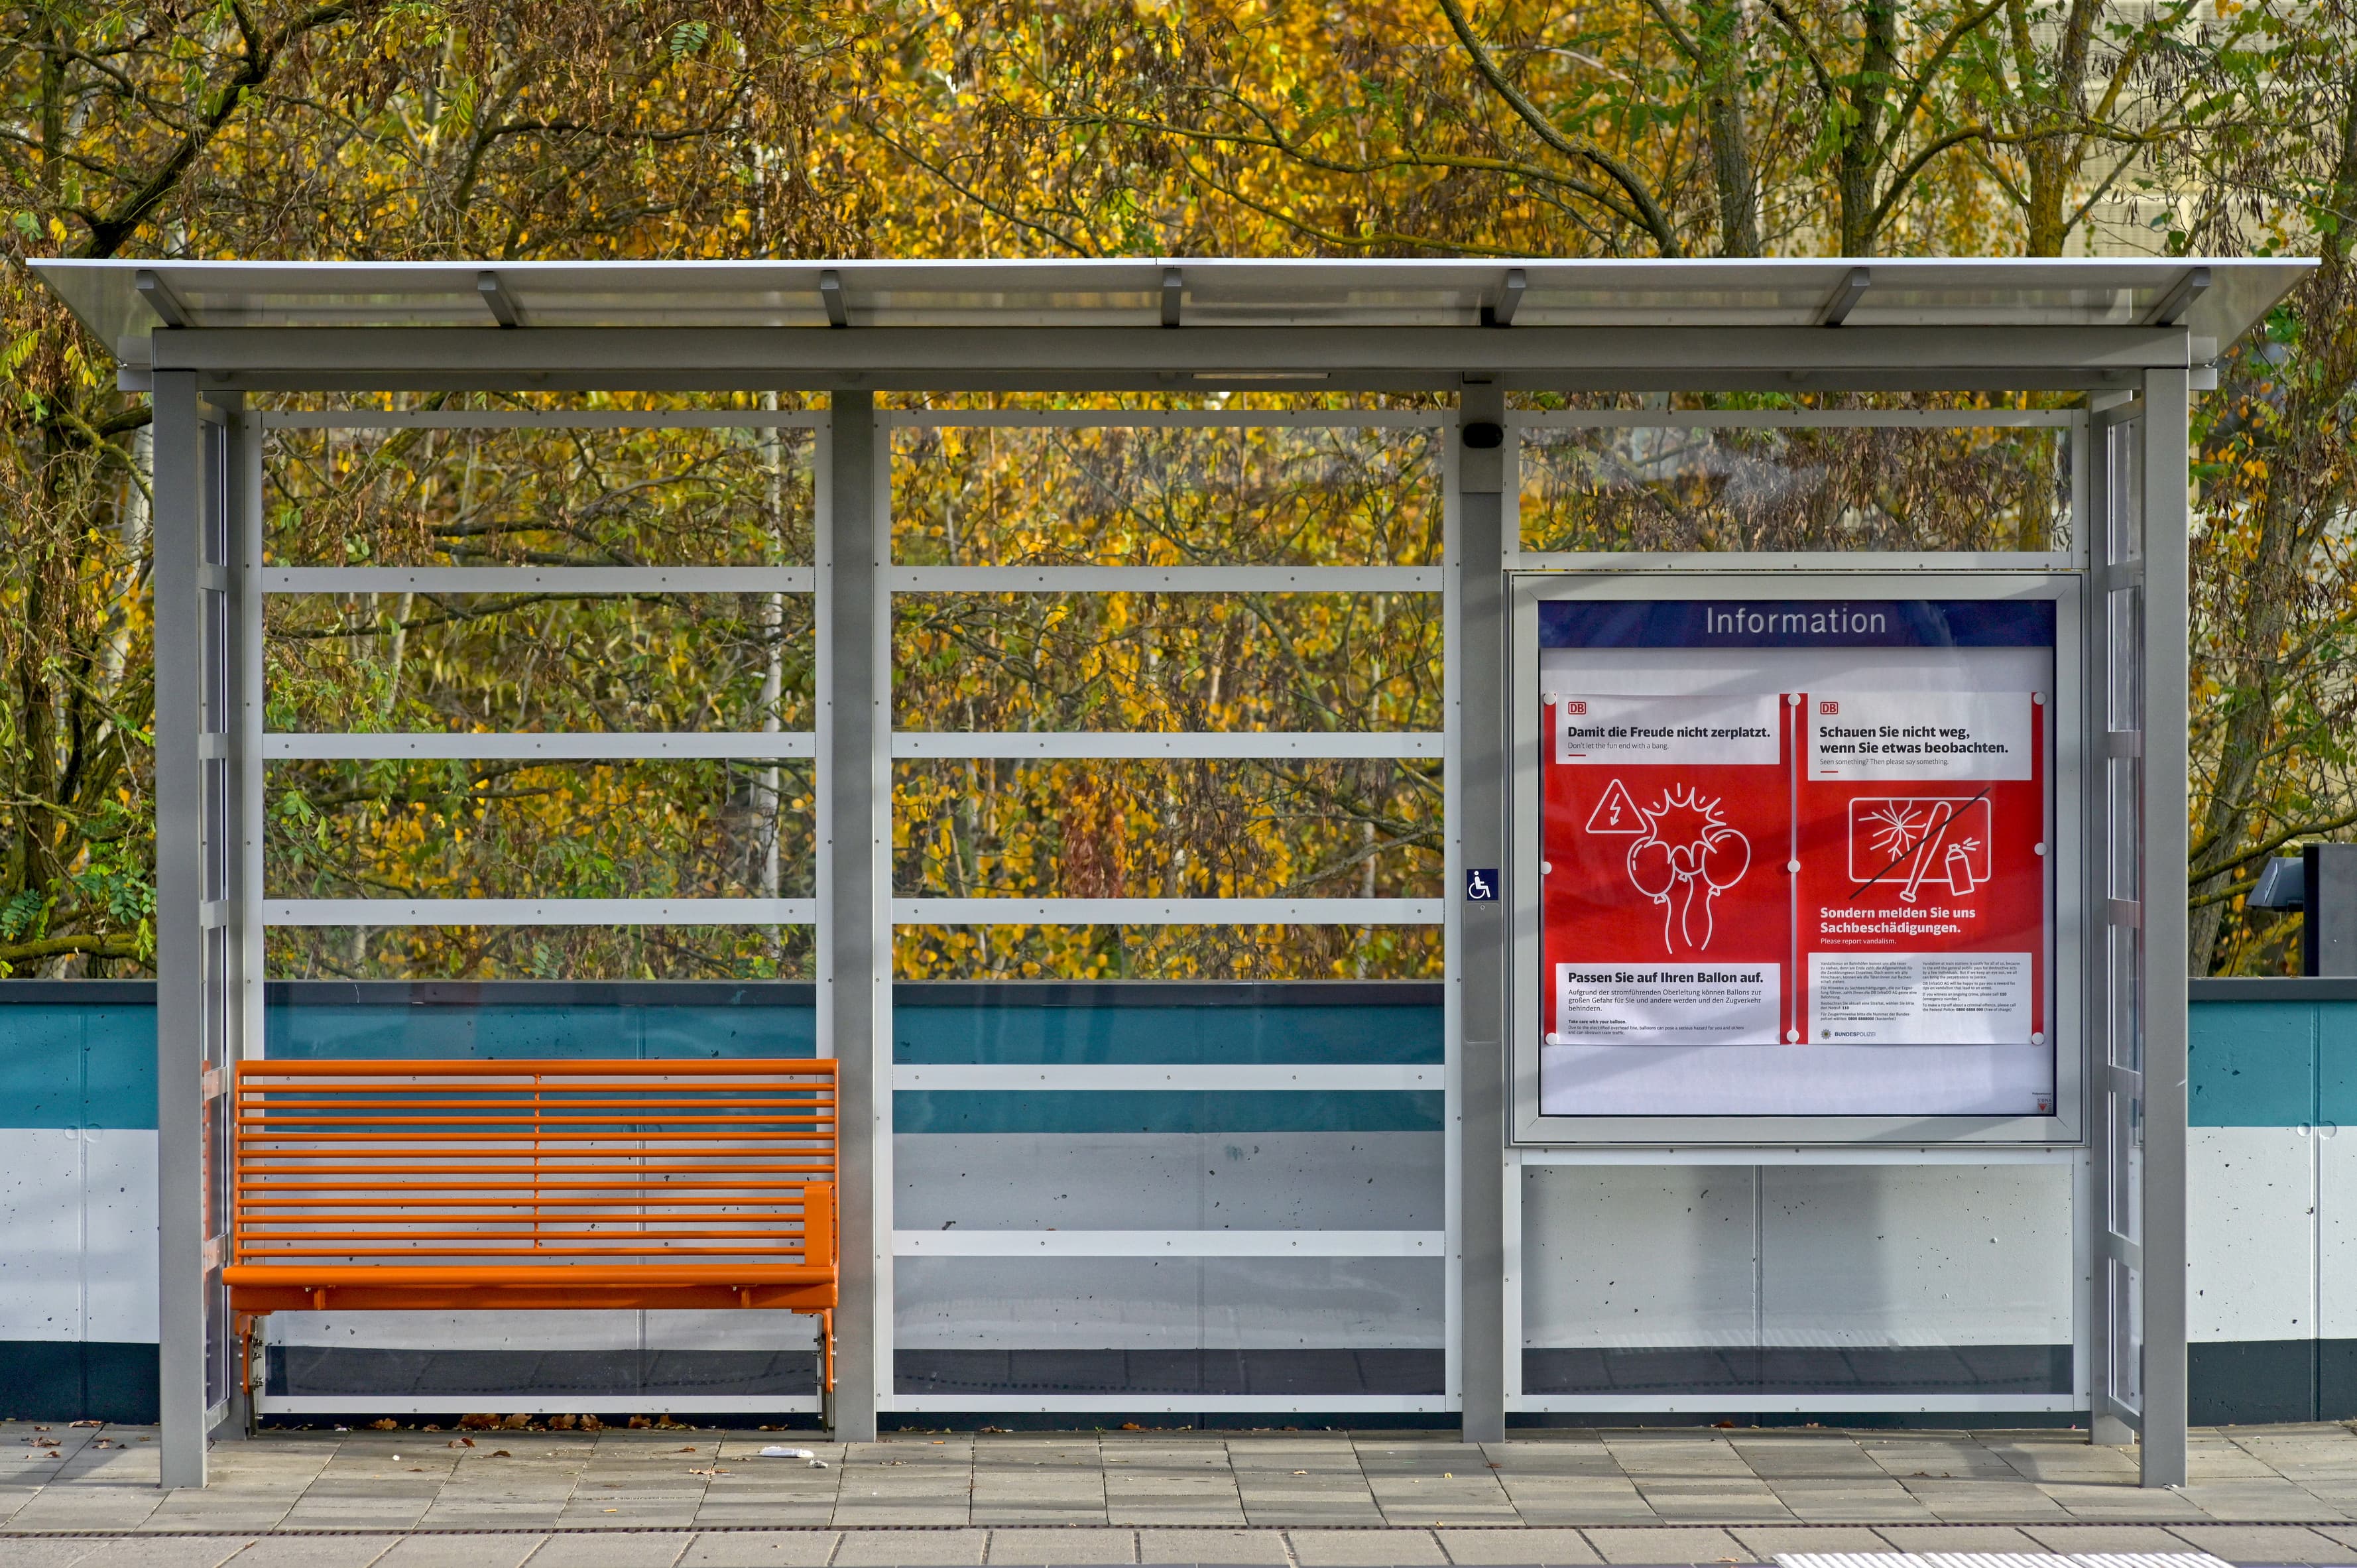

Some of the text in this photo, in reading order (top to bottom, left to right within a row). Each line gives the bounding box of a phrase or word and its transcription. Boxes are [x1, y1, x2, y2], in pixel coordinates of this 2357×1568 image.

[1707, 607, 1886, 633] Information
[1569, 703, 1585, 714] DB
[1821, 703, 1837, 714] DB
[1568, 726, 1770, 740] Damit die Freude nicht zerplatzt.
[1820, 726, 1969, 740] Schauen Sie nicht weg,
[1820, 742, 2008, 754] wenn Sie etwas beobachten.
[1820, 907, 1975, 918] Sondern melden Sie uns
[1821, 922, 1961, 935] Sachbeschädigungen.
[1568, 972, 1763, 983] Passen Sie auf Ihren Ballon auf.
